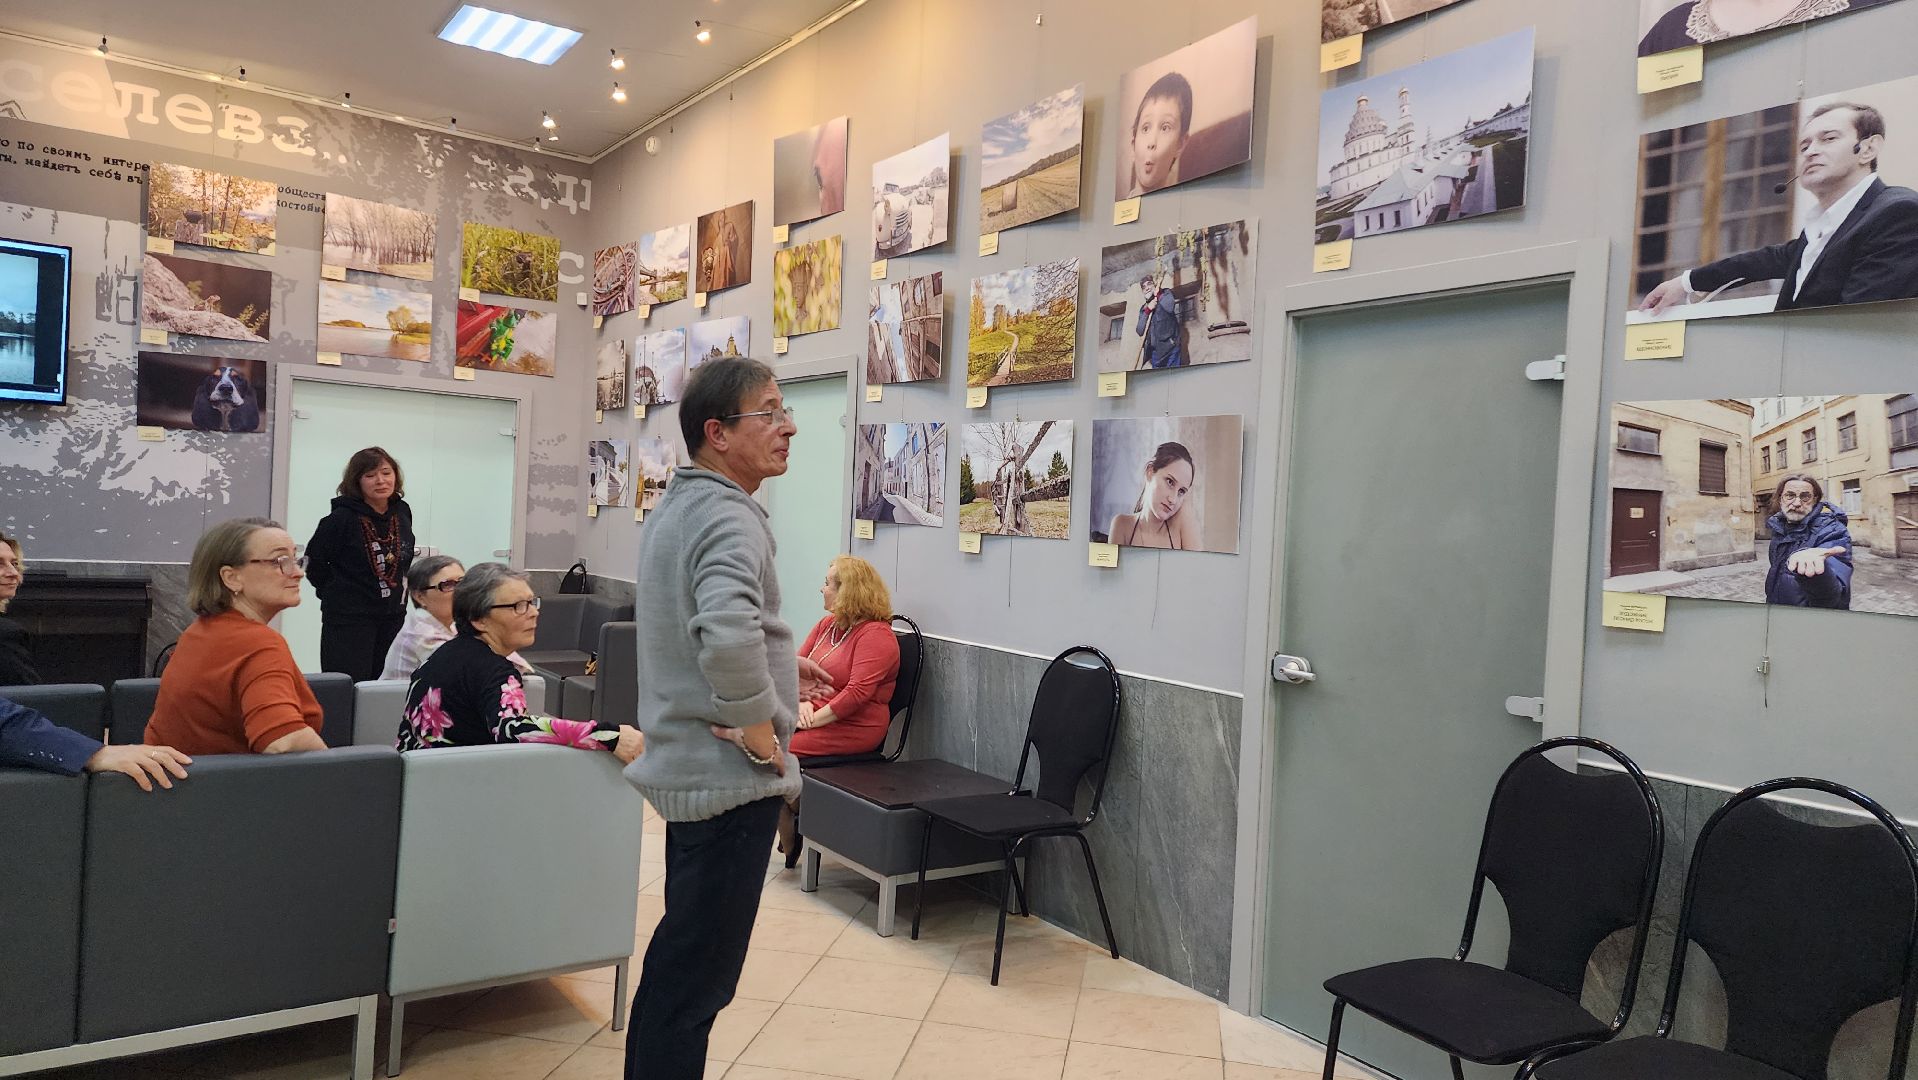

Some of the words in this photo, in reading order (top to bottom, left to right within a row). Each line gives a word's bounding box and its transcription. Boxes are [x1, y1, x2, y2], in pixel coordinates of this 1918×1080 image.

[17, 141, 35, 151] по
[42, 146, 92, 161] своимъ
[25, 157, 81, 174] найдетъ
[127, 174, 144, 185] въ
